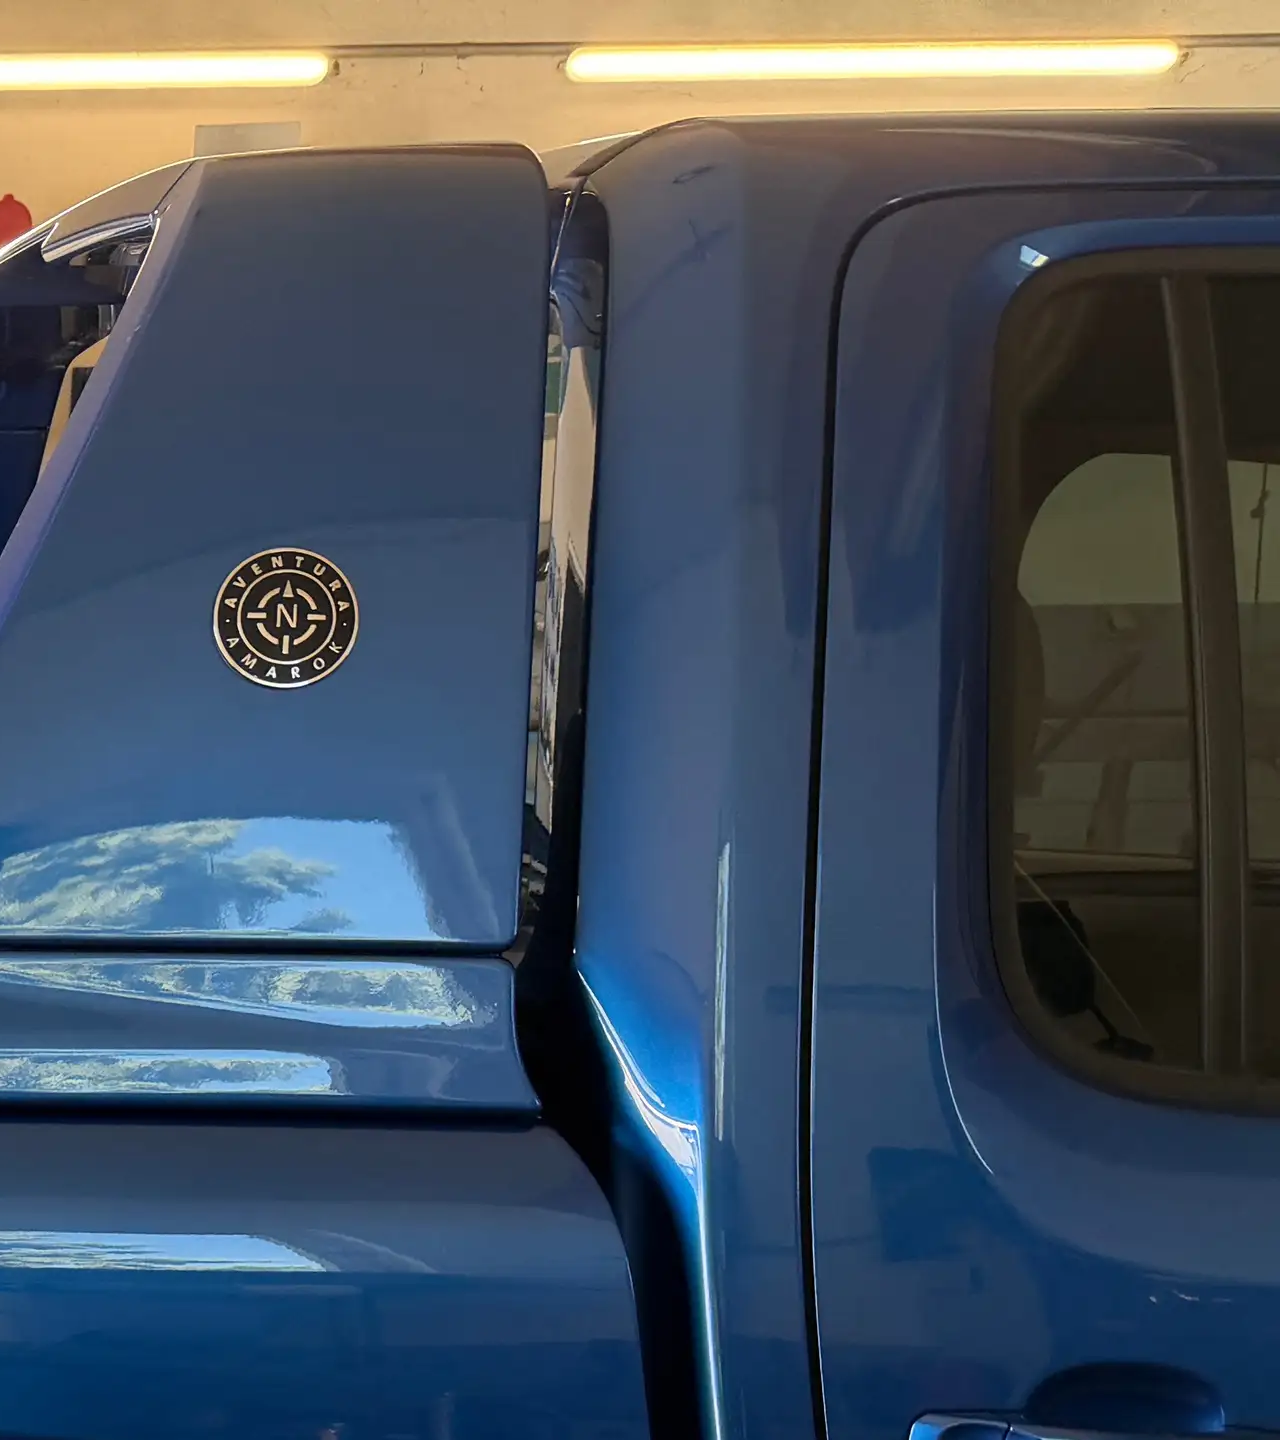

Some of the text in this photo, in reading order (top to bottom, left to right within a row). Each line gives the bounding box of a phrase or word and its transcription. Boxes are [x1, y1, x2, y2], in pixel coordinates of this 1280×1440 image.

[224, 555, 352, 613] AVENTURA
[275, 603, 299, 629] N
[226, 636, 343, 680] AMAROK
